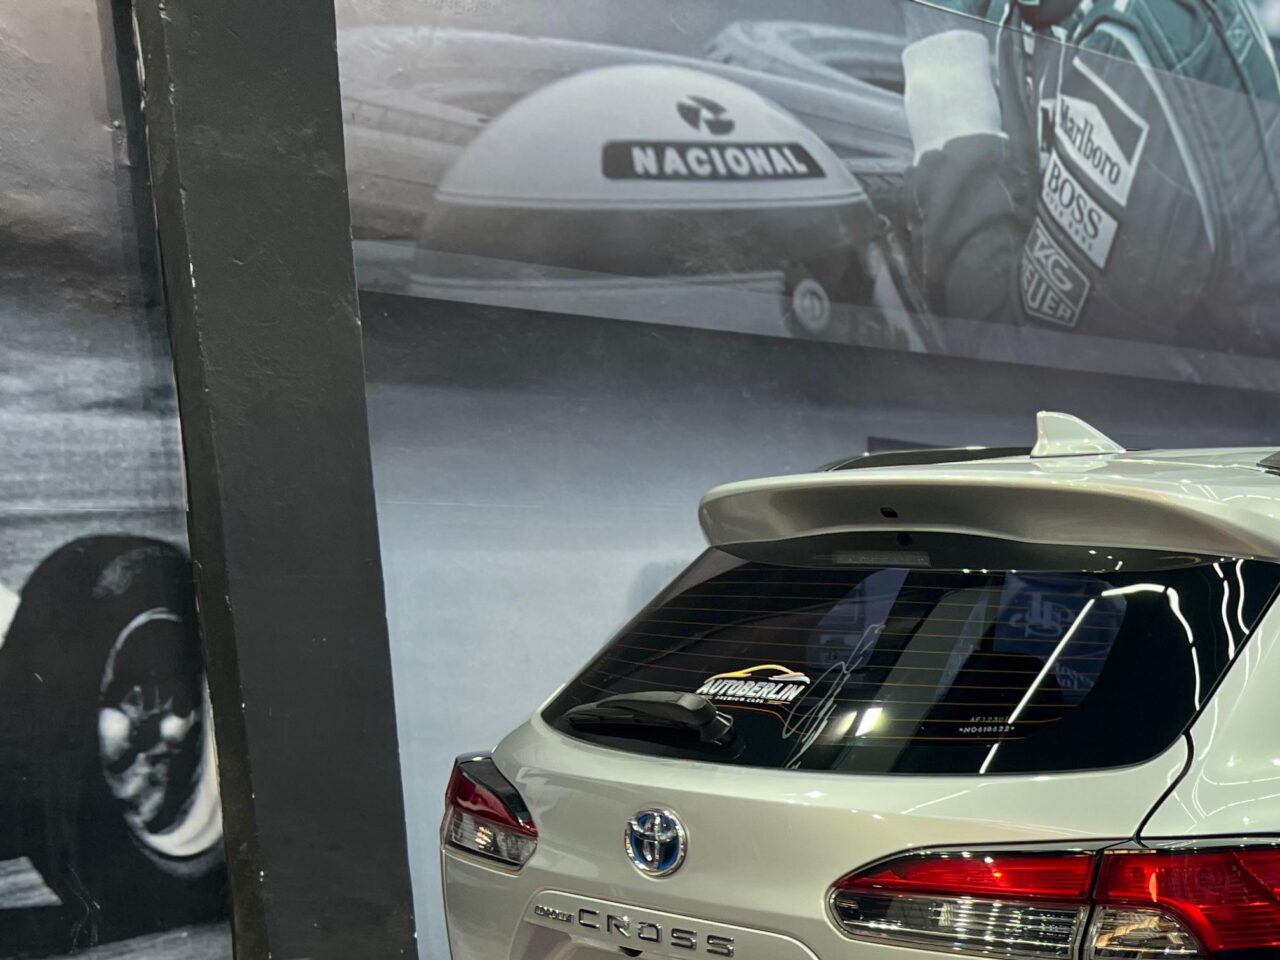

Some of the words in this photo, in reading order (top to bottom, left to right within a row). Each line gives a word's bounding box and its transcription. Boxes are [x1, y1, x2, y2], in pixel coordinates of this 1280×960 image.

[631, 145, 808, 176] NACIONAL
[1060, 97, 1121, 185] Marlboro
[1048, 161, 1102, 239] BOSS
[1023, 258, 1072, 320] EUER
[1033, 227, 1074, 291] TAG
[695, 679, 805, 701] AUTOBERLIN
[578, 908, 735, 957] CROSS
